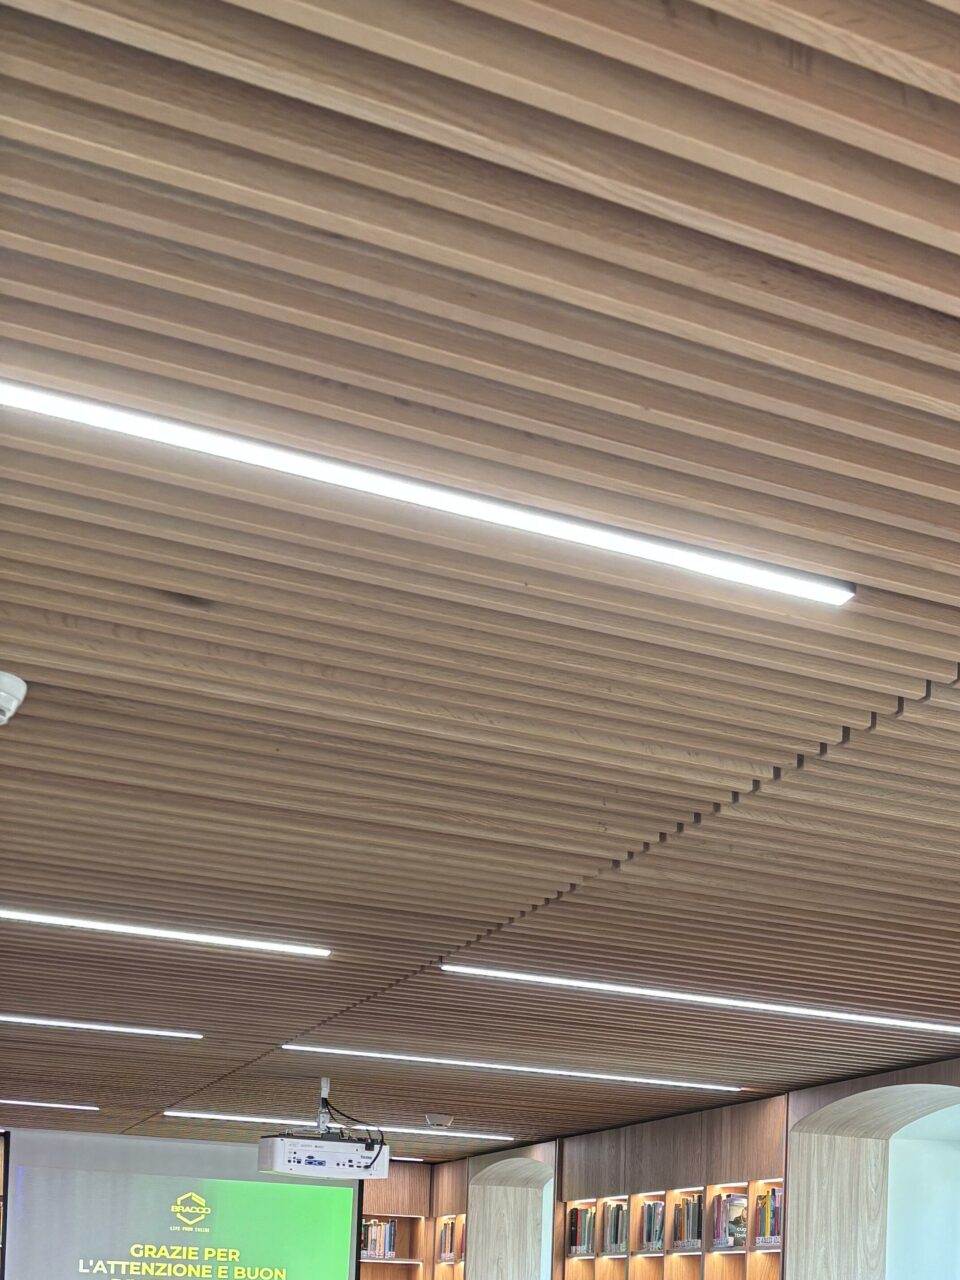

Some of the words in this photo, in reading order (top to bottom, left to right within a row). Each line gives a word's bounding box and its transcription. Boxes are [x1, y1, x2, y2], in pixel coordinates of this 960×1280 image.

[171, 1205, 211, 1214] BRACCO
[130, 1244, 199, 1260] GRAZIE
[204, 1248, 240, 1262] PER
[78, 1259, 213, 1279] L'ATTENZIONE
[217, 1265, 229, 1279] E
[234, 1266, 287, 1280] BUON
